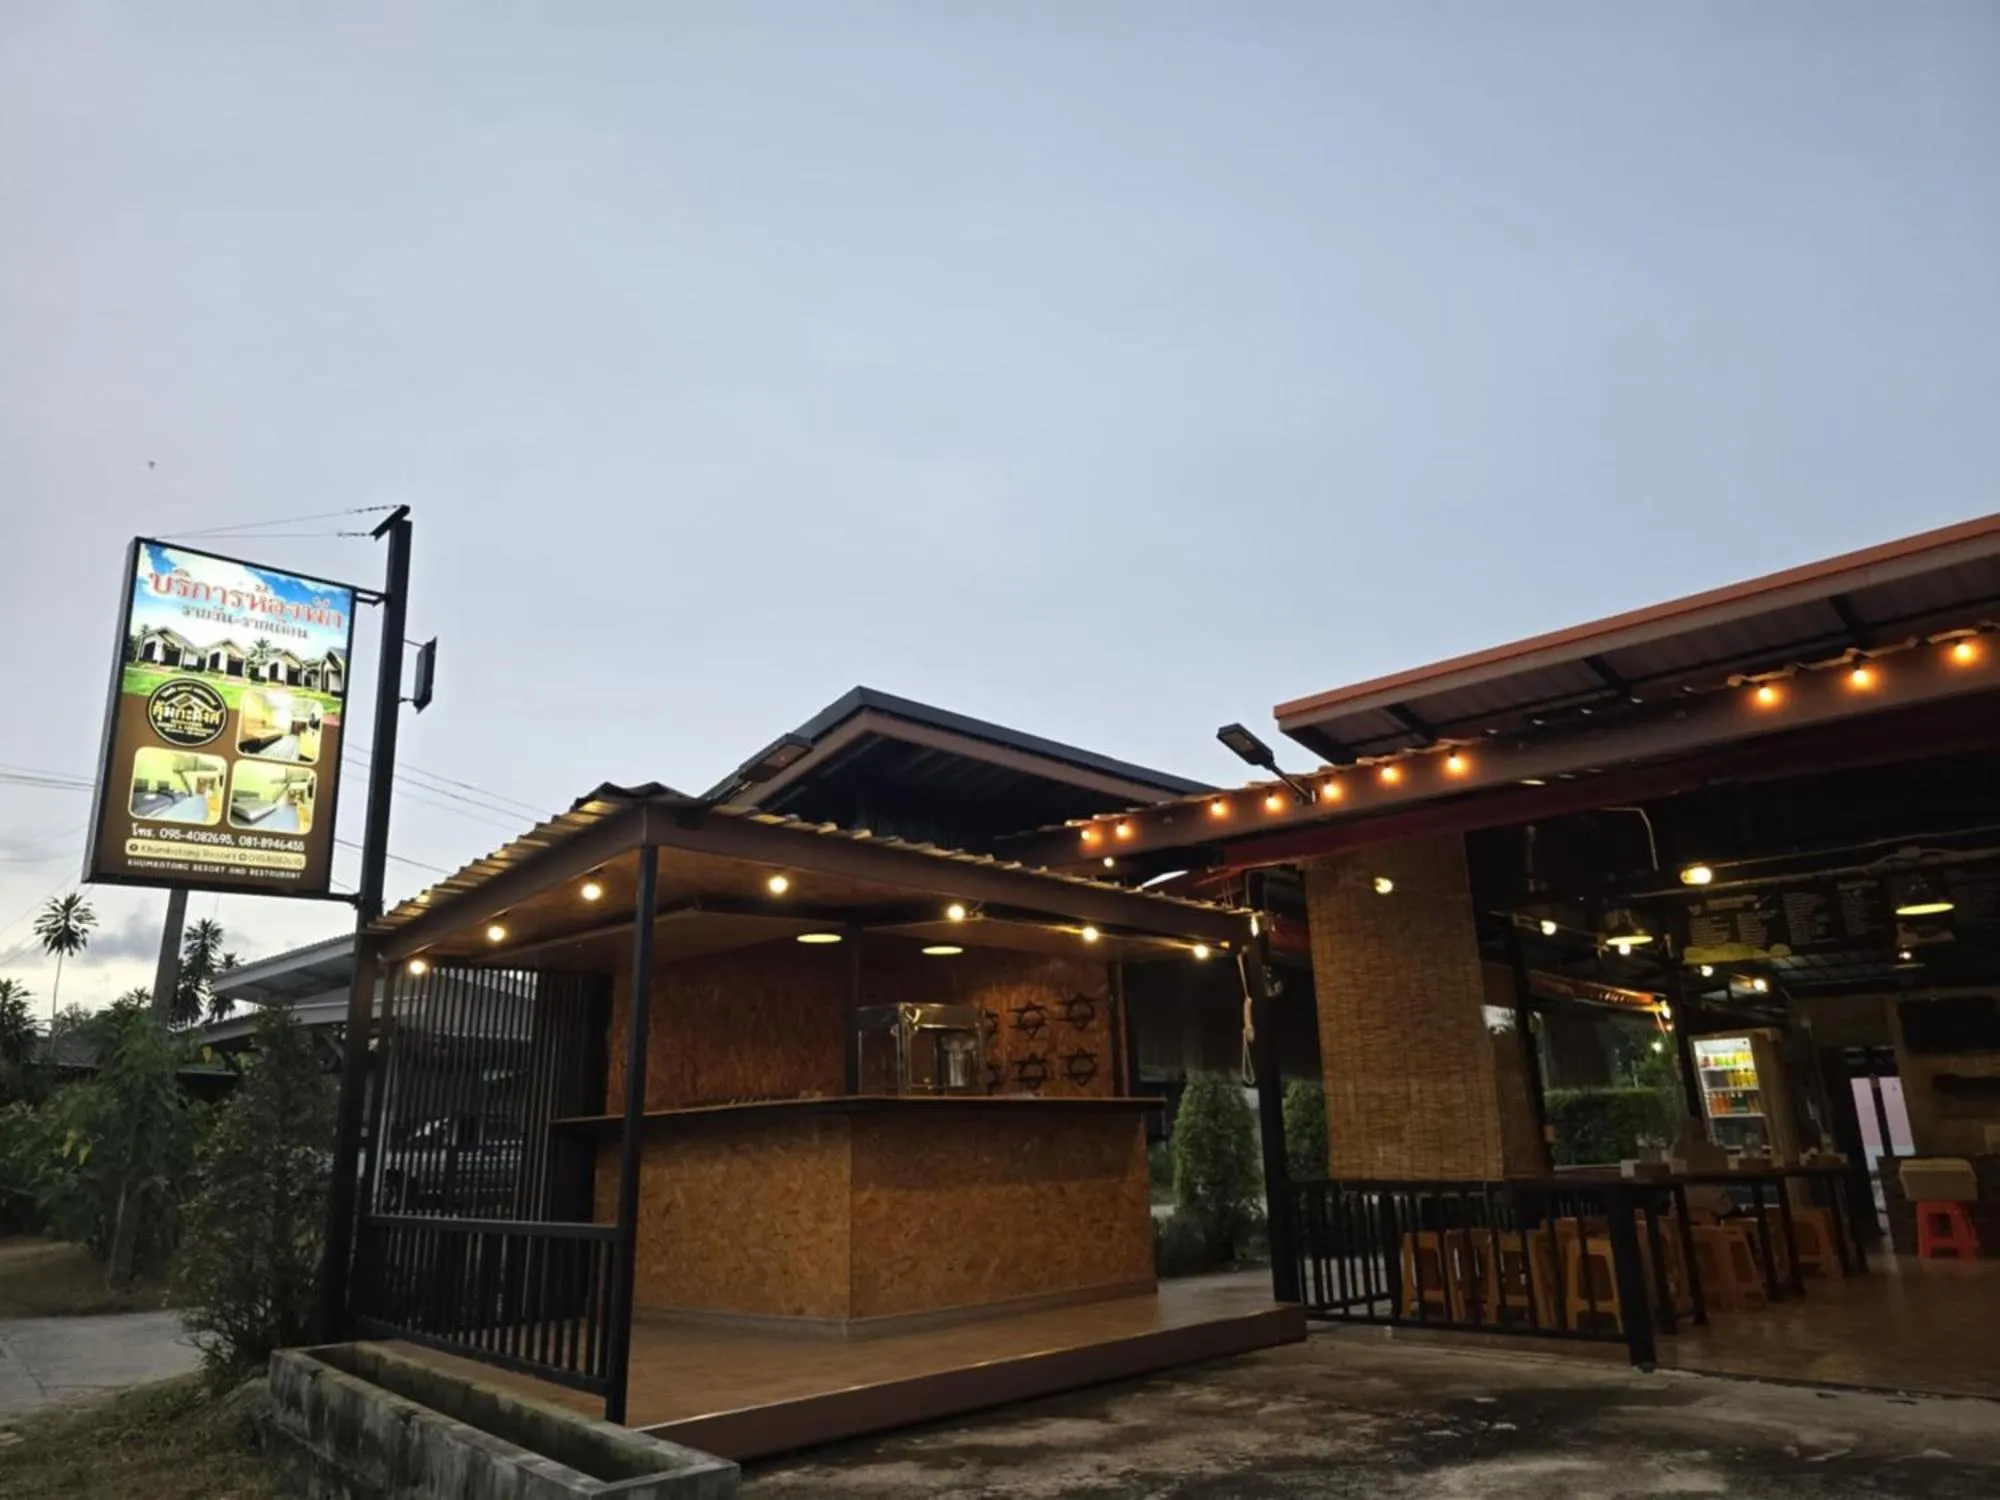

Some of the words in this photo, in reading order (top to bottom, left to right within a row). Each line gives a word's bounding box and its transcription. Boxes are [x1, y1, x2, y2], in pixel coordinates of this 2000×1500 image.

[149, 568, 342, 628] บริการห้องพัก
